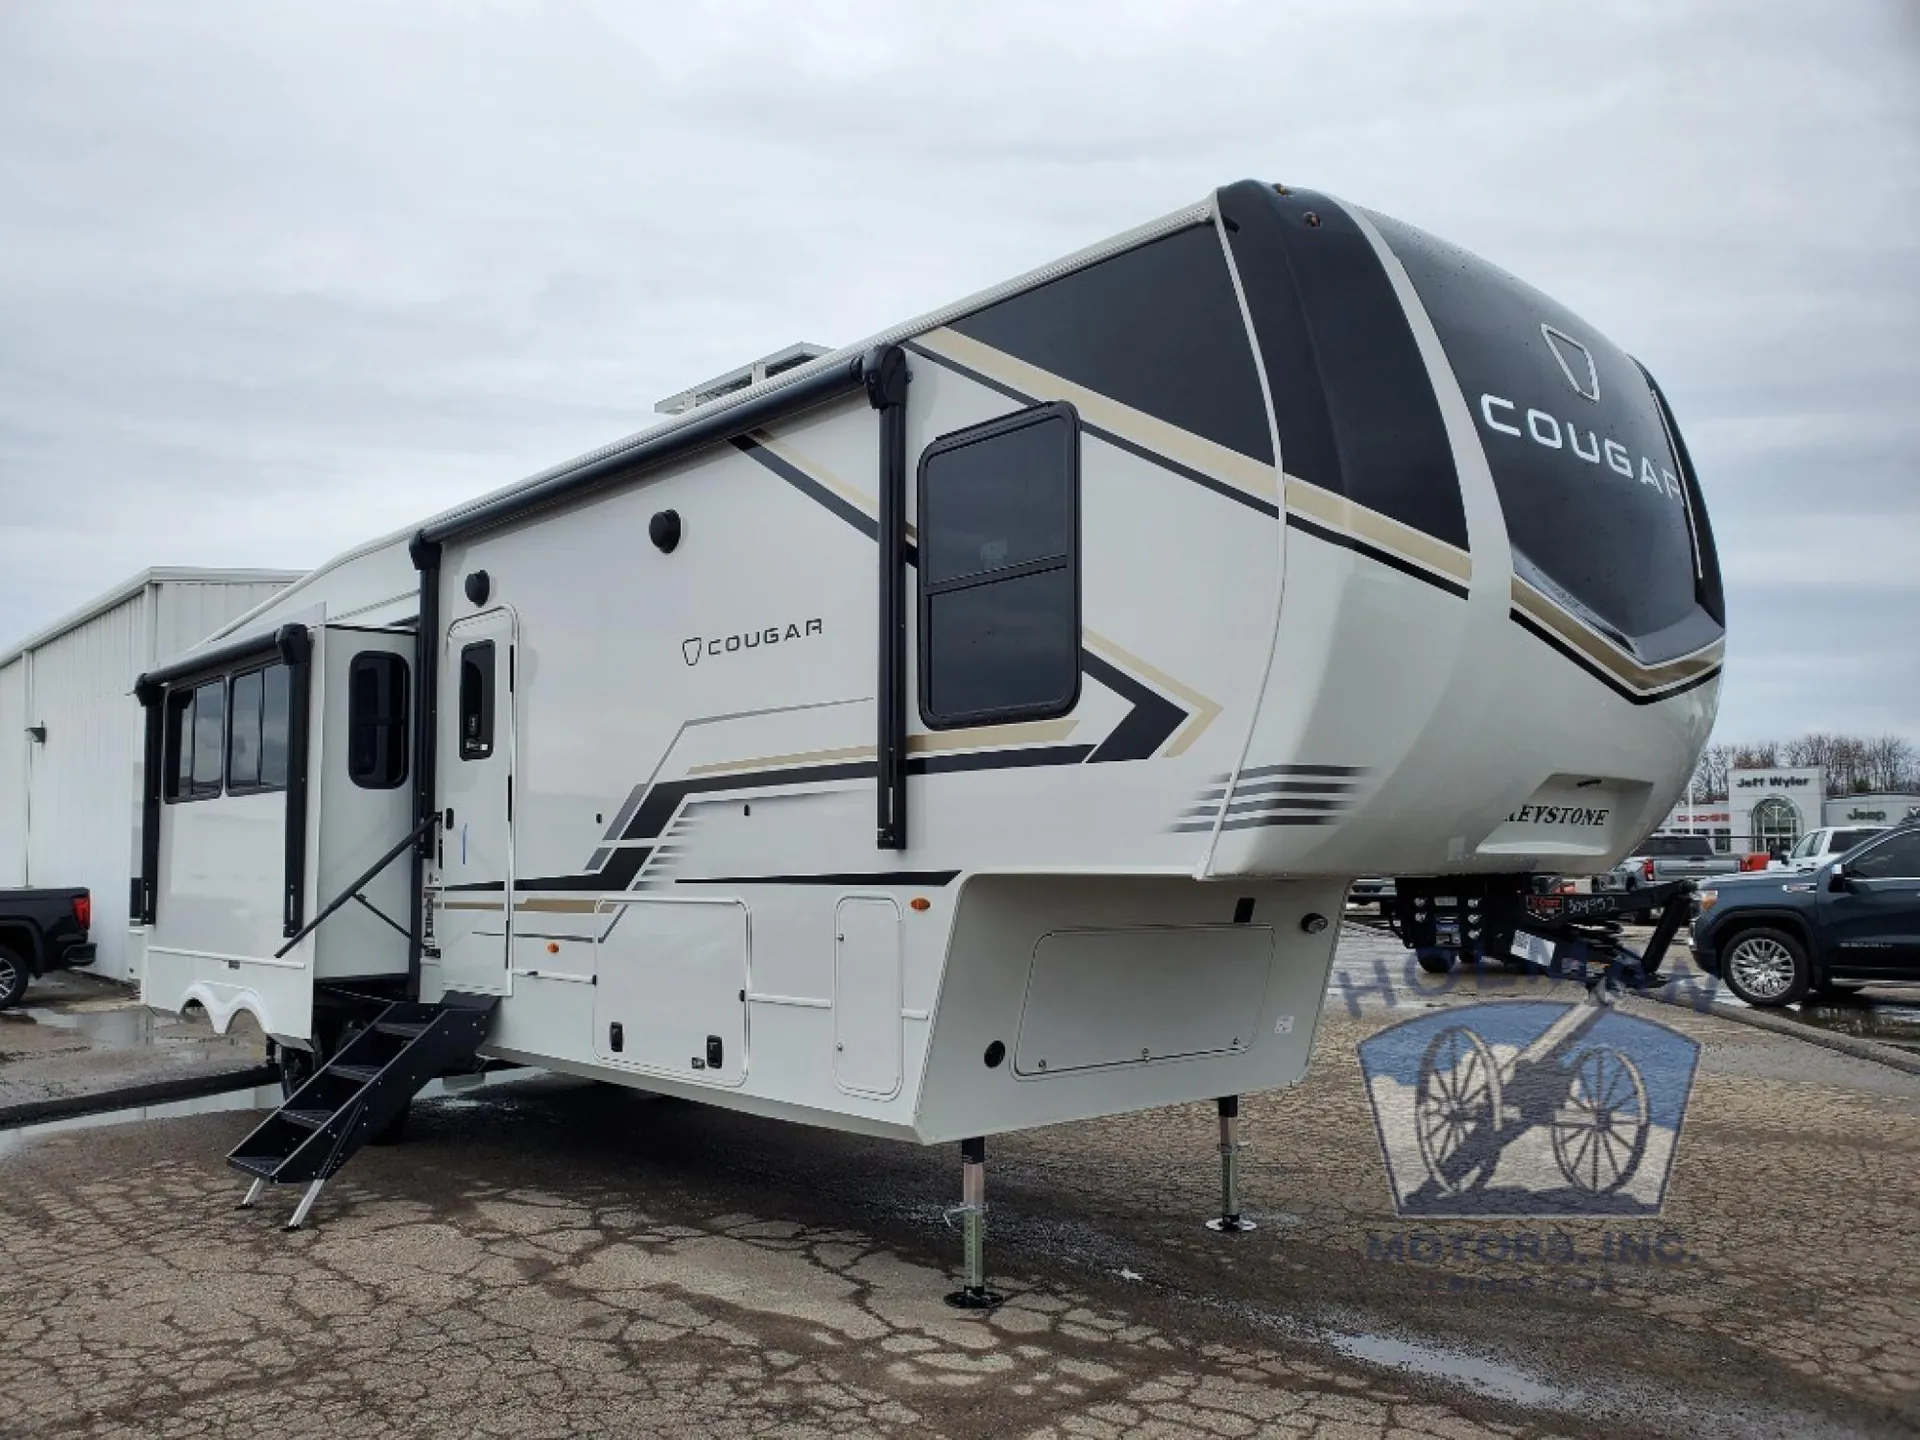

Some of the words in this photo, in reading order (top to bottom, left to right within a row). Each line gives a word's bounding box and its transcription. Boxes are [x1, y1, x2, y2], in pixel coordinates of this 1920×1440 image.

[708, 618, 822, 655] COUGAR
[1736, 777, 1765, 788] Jeff
[1770, 775, 1810, 788] Wyler
[1847, 807, 1886, 821] Jeep
